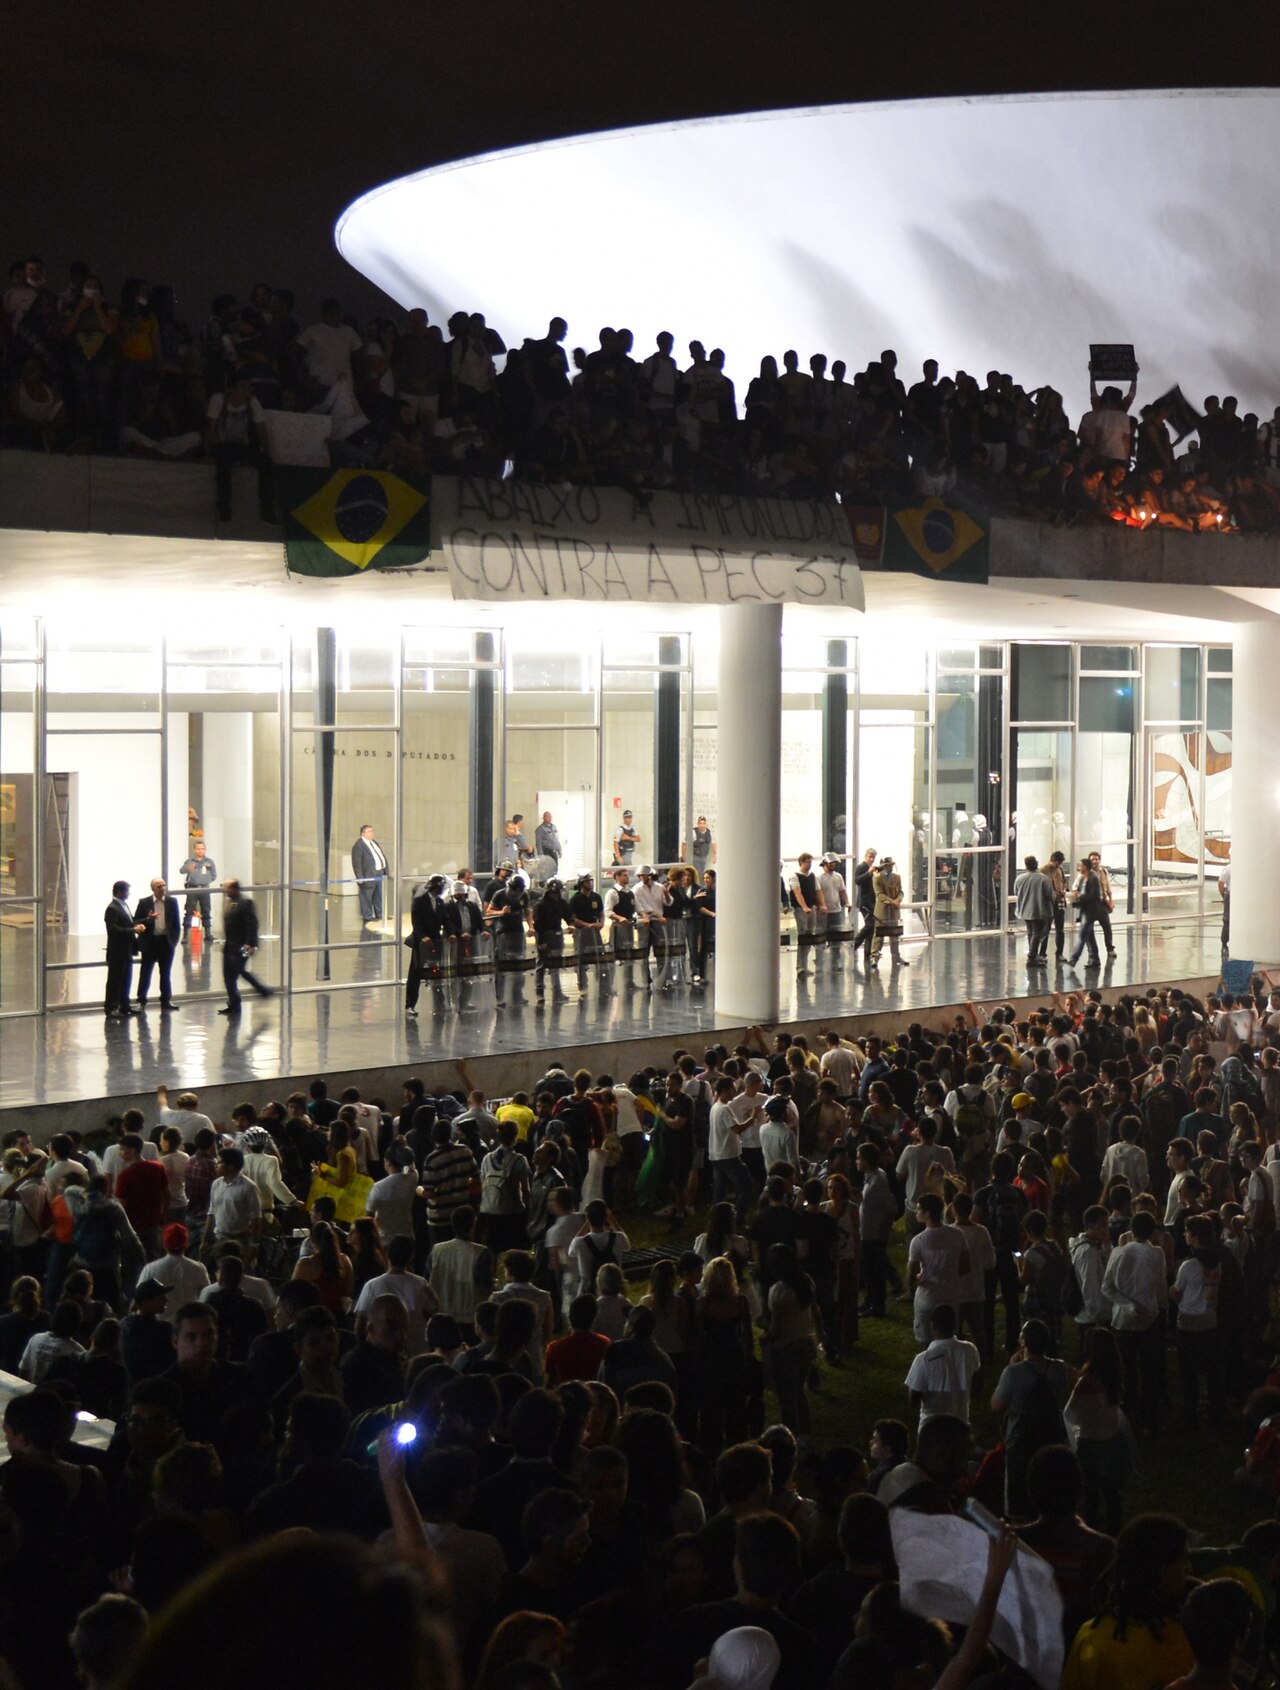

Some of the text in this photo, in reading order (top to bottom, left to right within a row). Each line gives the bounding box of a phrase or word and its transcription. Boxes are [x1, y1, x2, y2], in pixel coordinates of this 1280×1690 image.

[456, 475, 601, 528] ABAIXO
[450, 528, 849, 602] CONTRA A PEC 37
[356, 749, 377, 758] DOS
[387, 750, 456, 761] DPUTADOS
